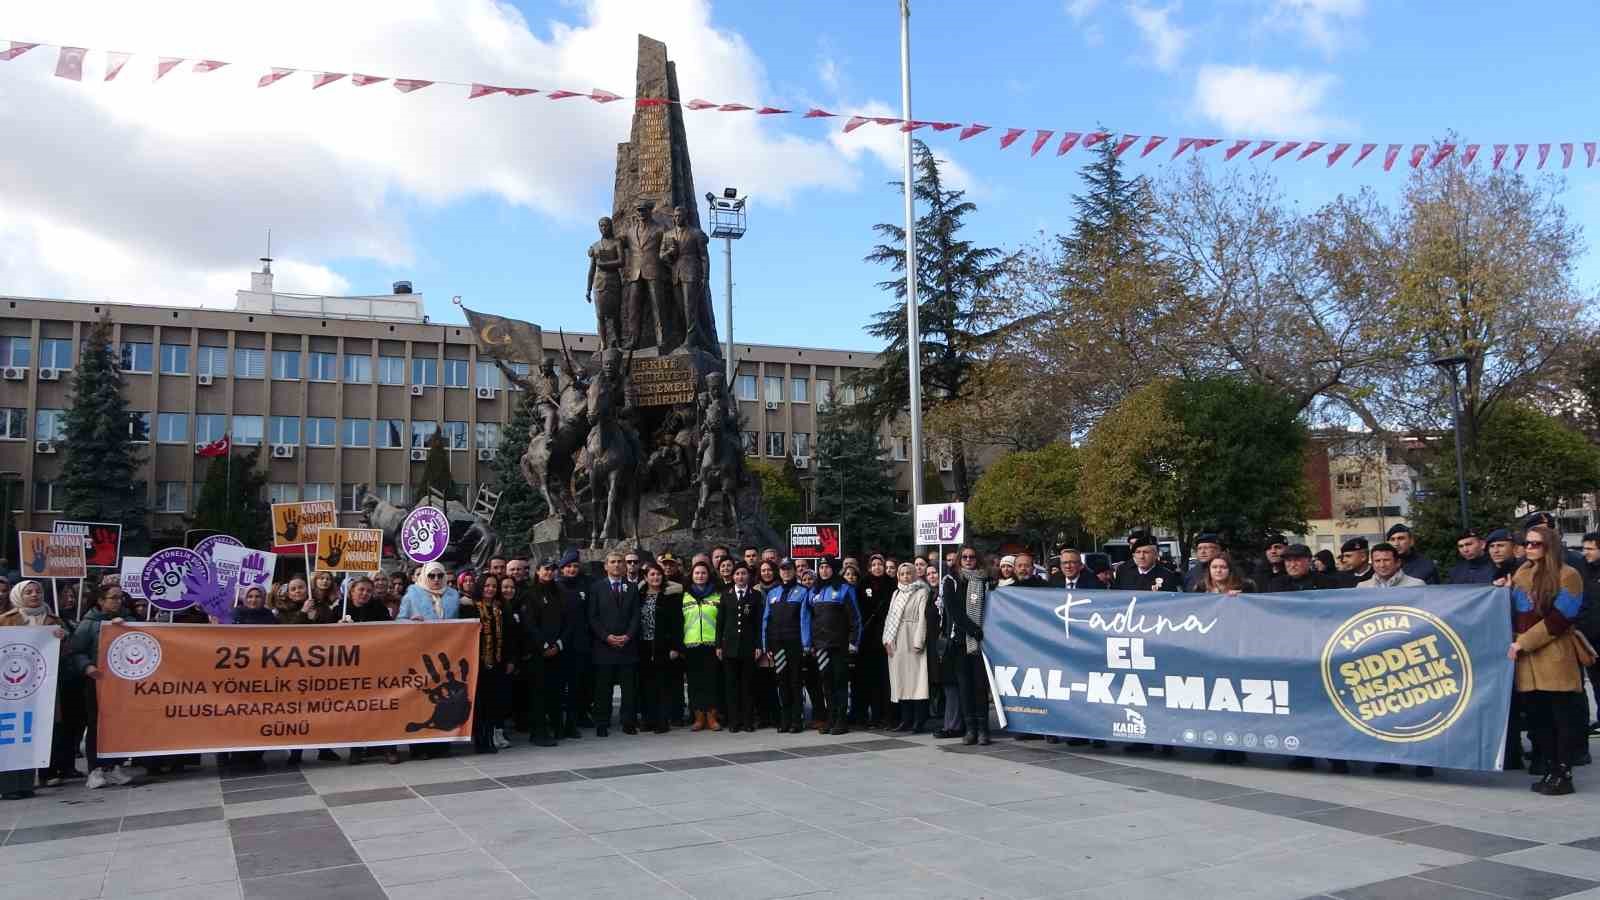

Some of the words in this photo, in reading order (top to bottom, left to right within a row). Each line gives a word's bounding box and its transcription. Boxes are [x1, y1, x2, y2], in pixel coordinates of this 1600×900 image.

[1340, 615, 1411, 650] KADINA
[215, 646, 250, 669] 25
[261, 645, 361, 669] KASIM
[1106, 637, 1156, 670] EL
[134, 680, 206, 696] KADINA
[211, 676, 291, 694] YÖNELİK
[297, 675, 372, 694] ŞİDDETE
[994, 665, 1290, 715] KAL-KA-MAZ!
[1350, 658, 1454, 704] İNSANLIK
[165, 702, 300, 719] ULUSLARARASI
[306, 698, 399, 714] MÜCADELE
[1358, 678, 1460, 721] SUÇUDUR
[259, 721, 310, 738] GÜNÜ
